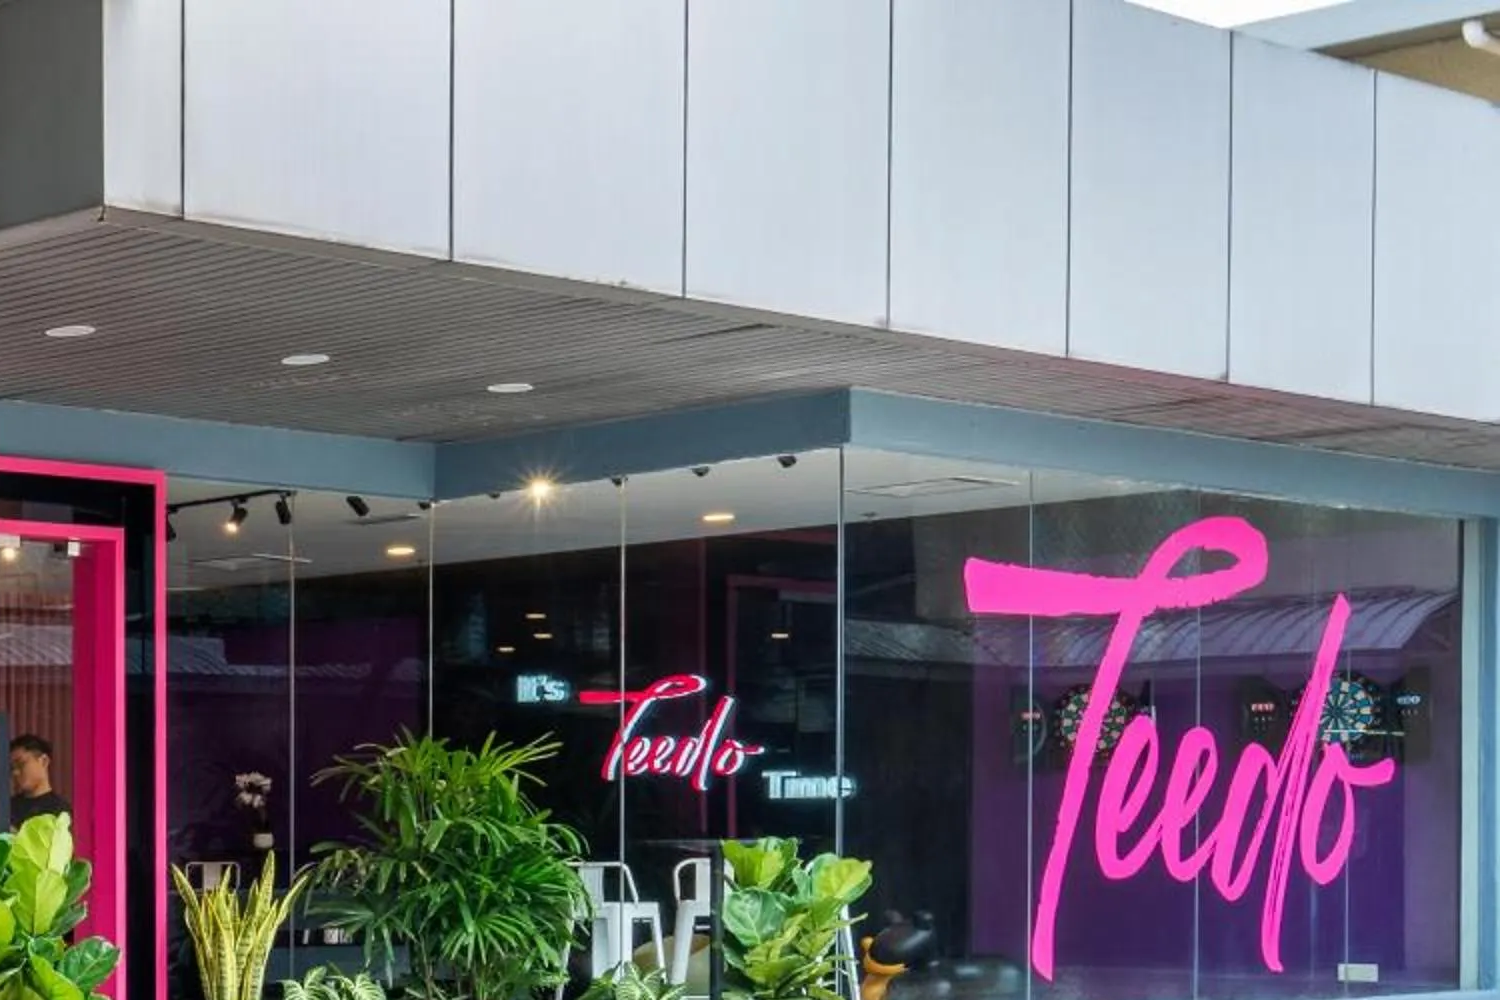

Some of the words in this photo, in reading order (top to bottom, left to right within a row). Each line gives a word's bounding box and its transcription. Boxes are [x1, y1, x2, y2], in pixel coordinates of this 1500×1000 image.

[579, 674, 764, 791] Teedo
[761, 771, 854, 799] Time
[963, 516, 1395, 982] Teedo
